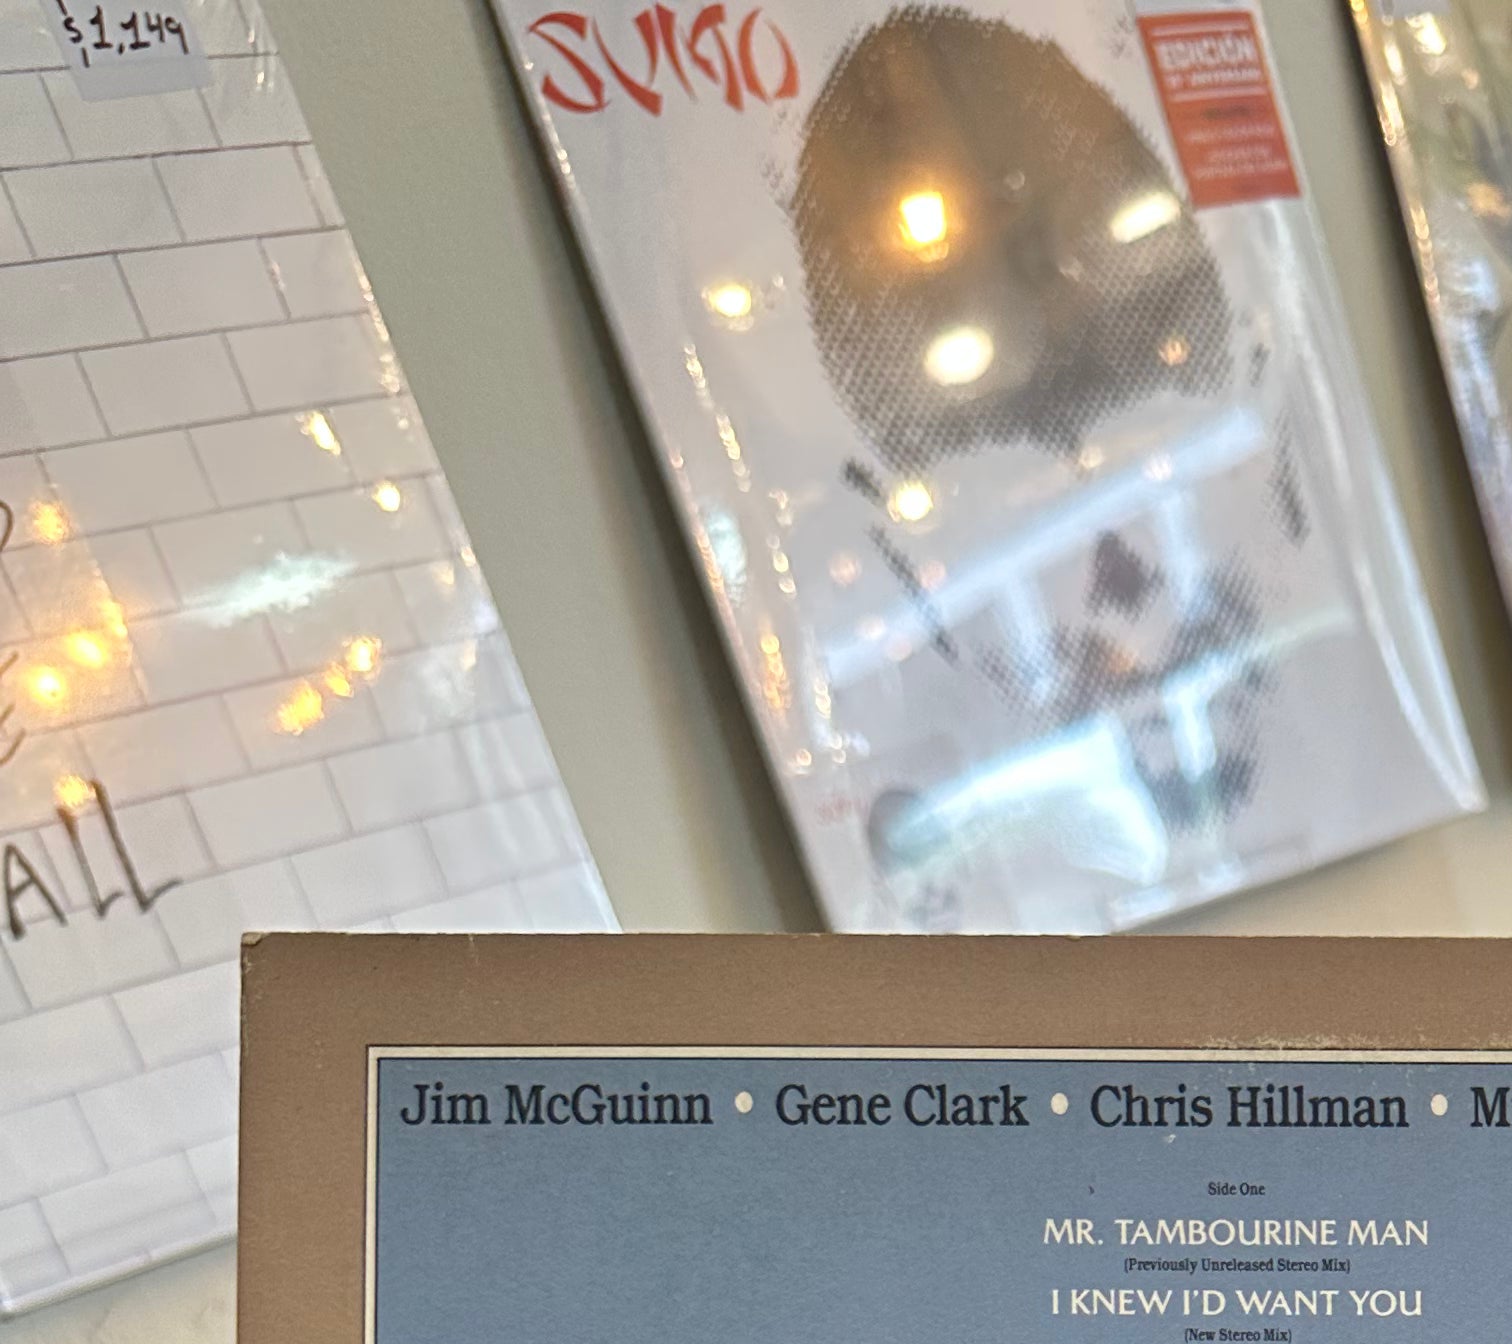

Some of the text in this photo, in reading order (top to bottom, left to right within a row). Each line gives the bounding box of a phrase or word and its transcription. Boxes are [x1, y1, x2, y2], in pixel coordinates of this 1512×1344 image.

[399, 1081, 492, 1126] Jim
[504, 1081, 714, 1126] McGuinn
[775, 1083, 892, 1126] Gene
[903, 1083, 1030, 1127] Clark
[1090, 1083, 1213, 1128] Chris
[1226, 1083, 1410, 1128] Hillman
[1207, 1181, 1266, 1196] Side One
[1043, 1218, 1428, 1246] MR. TAMBOURINE MAN
[1124, 1257, 1351, 1276] (Previously Unreleased Stereo Mix)
[1052, 1289, 1422, 1317] I KNEW I'D WANT YOU
[1184, 1327, 1292, 1344] (New Stereo Mix)
